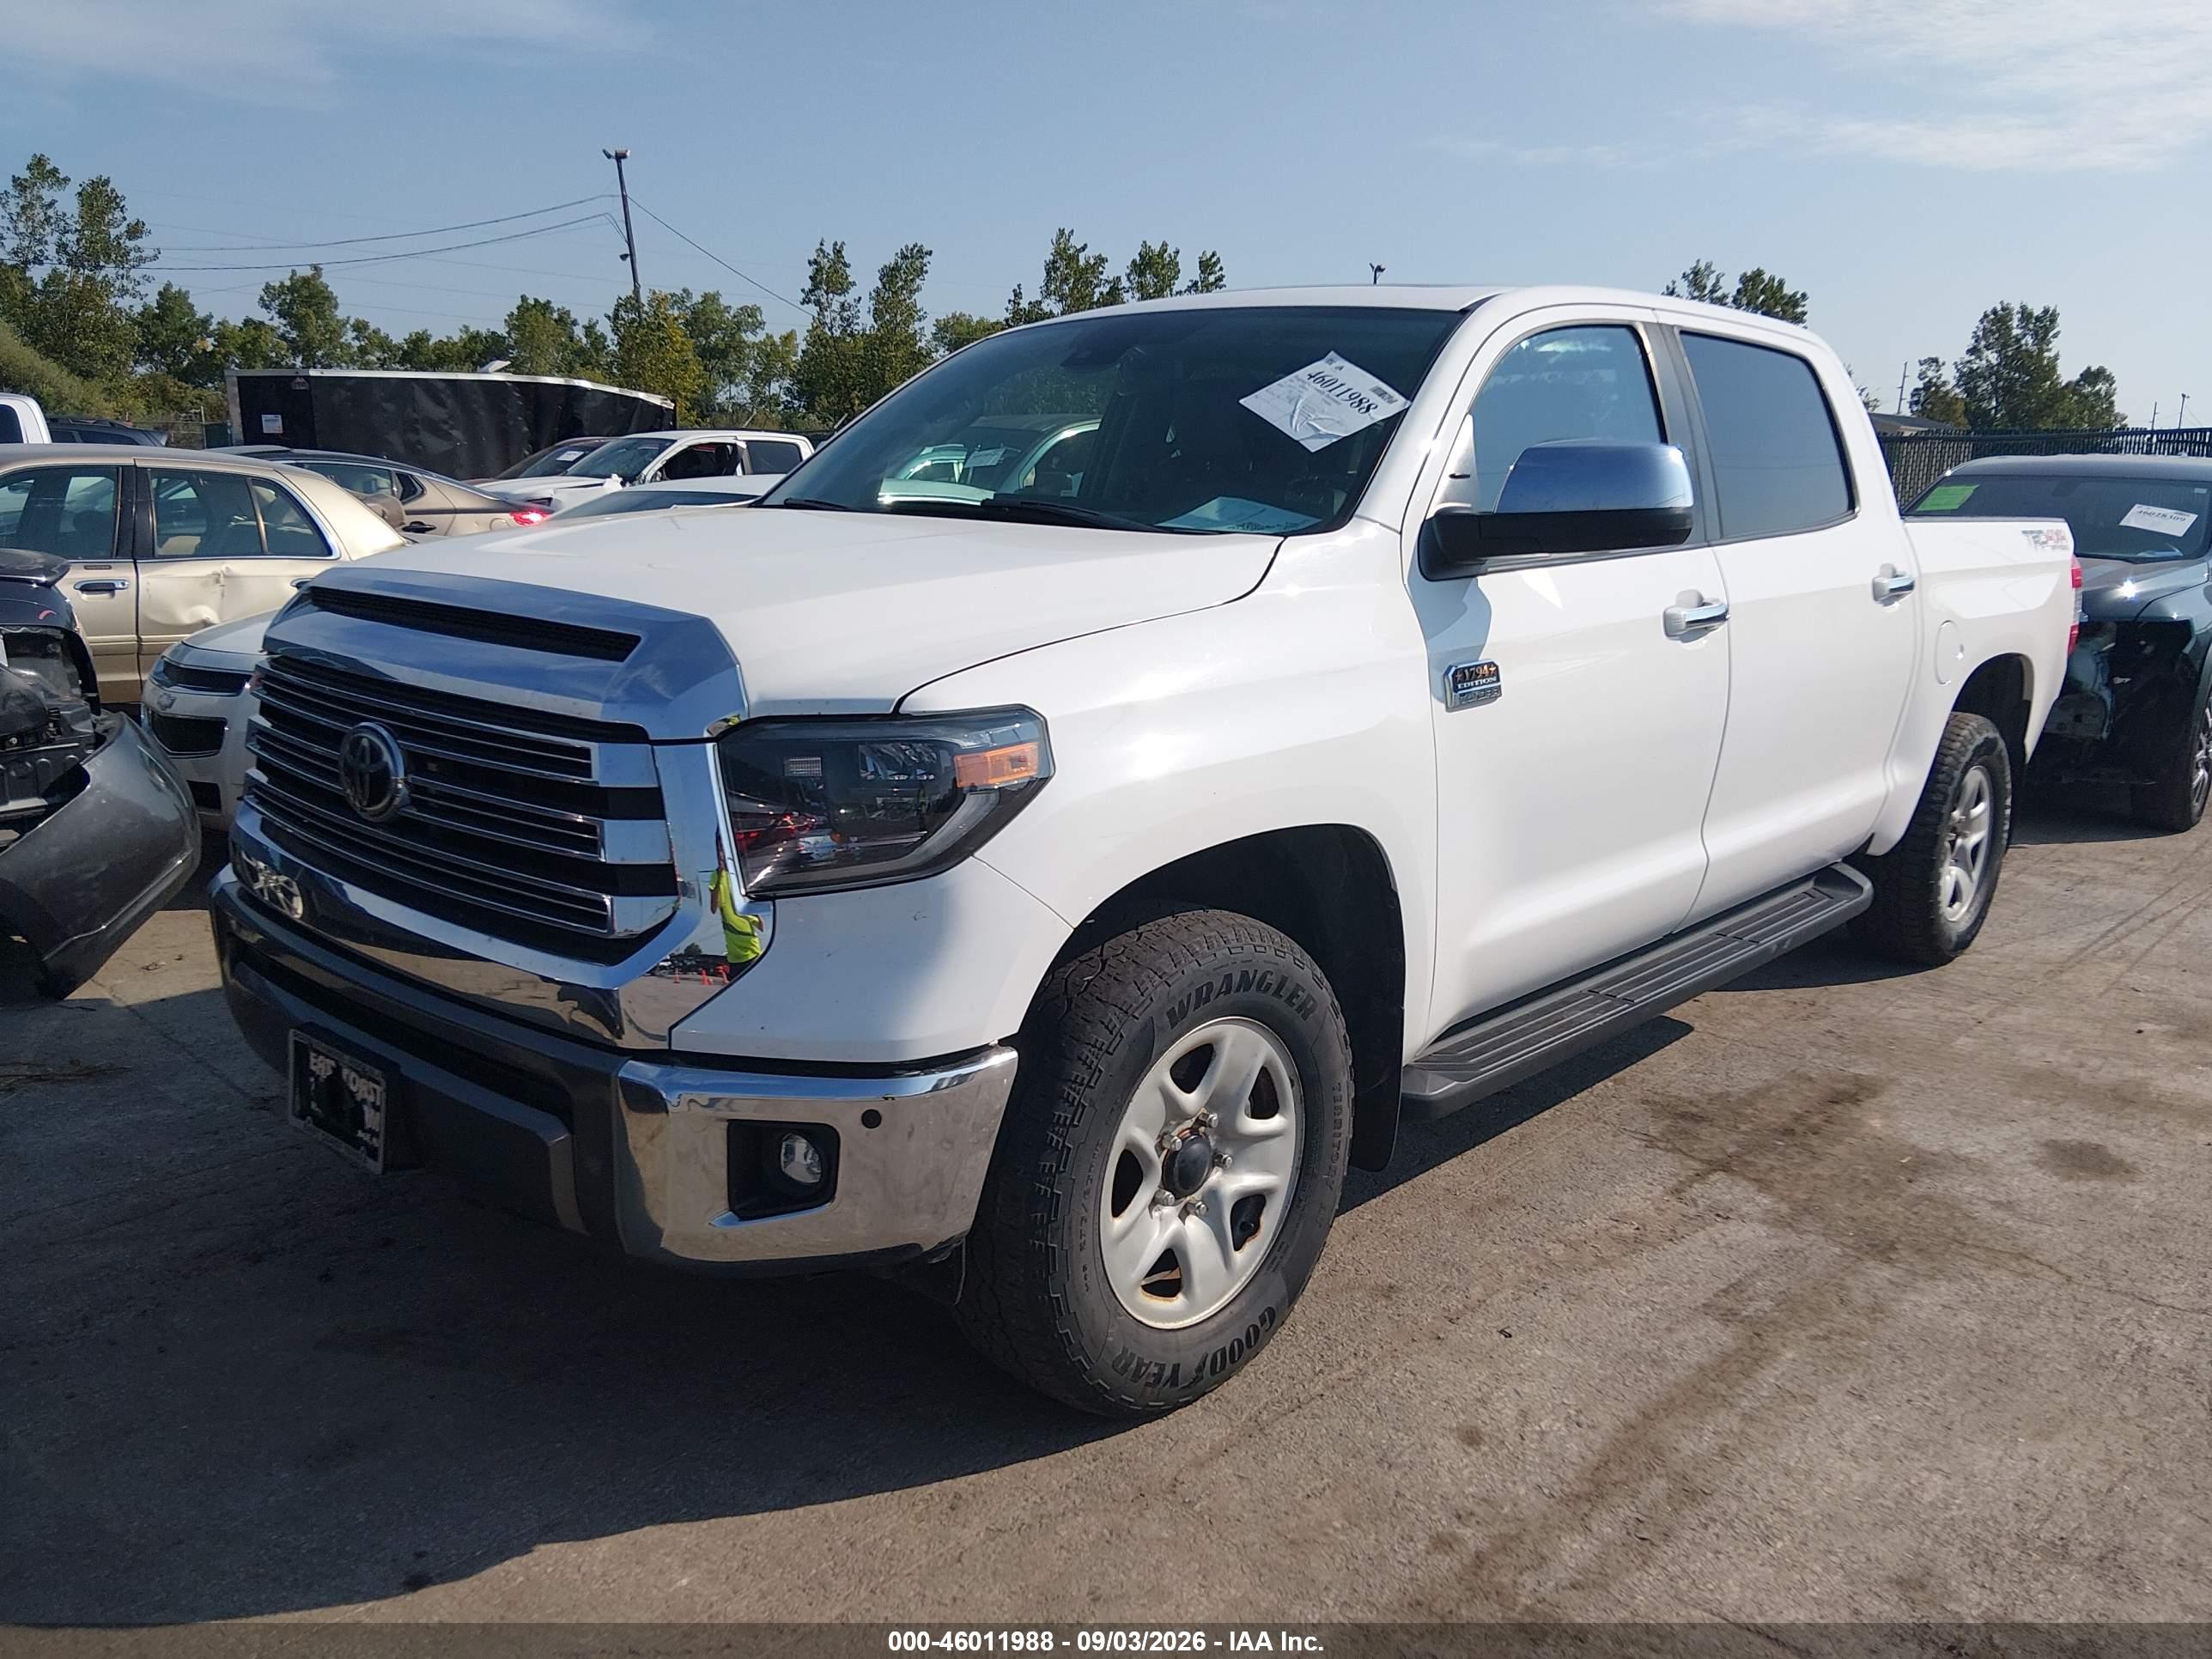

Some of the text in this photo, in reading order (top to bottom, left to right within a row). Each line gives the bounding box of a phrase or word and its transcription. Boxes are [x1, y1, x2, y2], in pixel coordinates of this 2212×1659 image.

[1307, 371, 1379, 415] 46011988
[1457, 676, 1498, 690] EDITION
[1464, 665, 1490, 681] 1794
[1166, 969, 1318, 1030] WRANGLER
[1112, 1306, 1277, 1389] GOODYEAR
